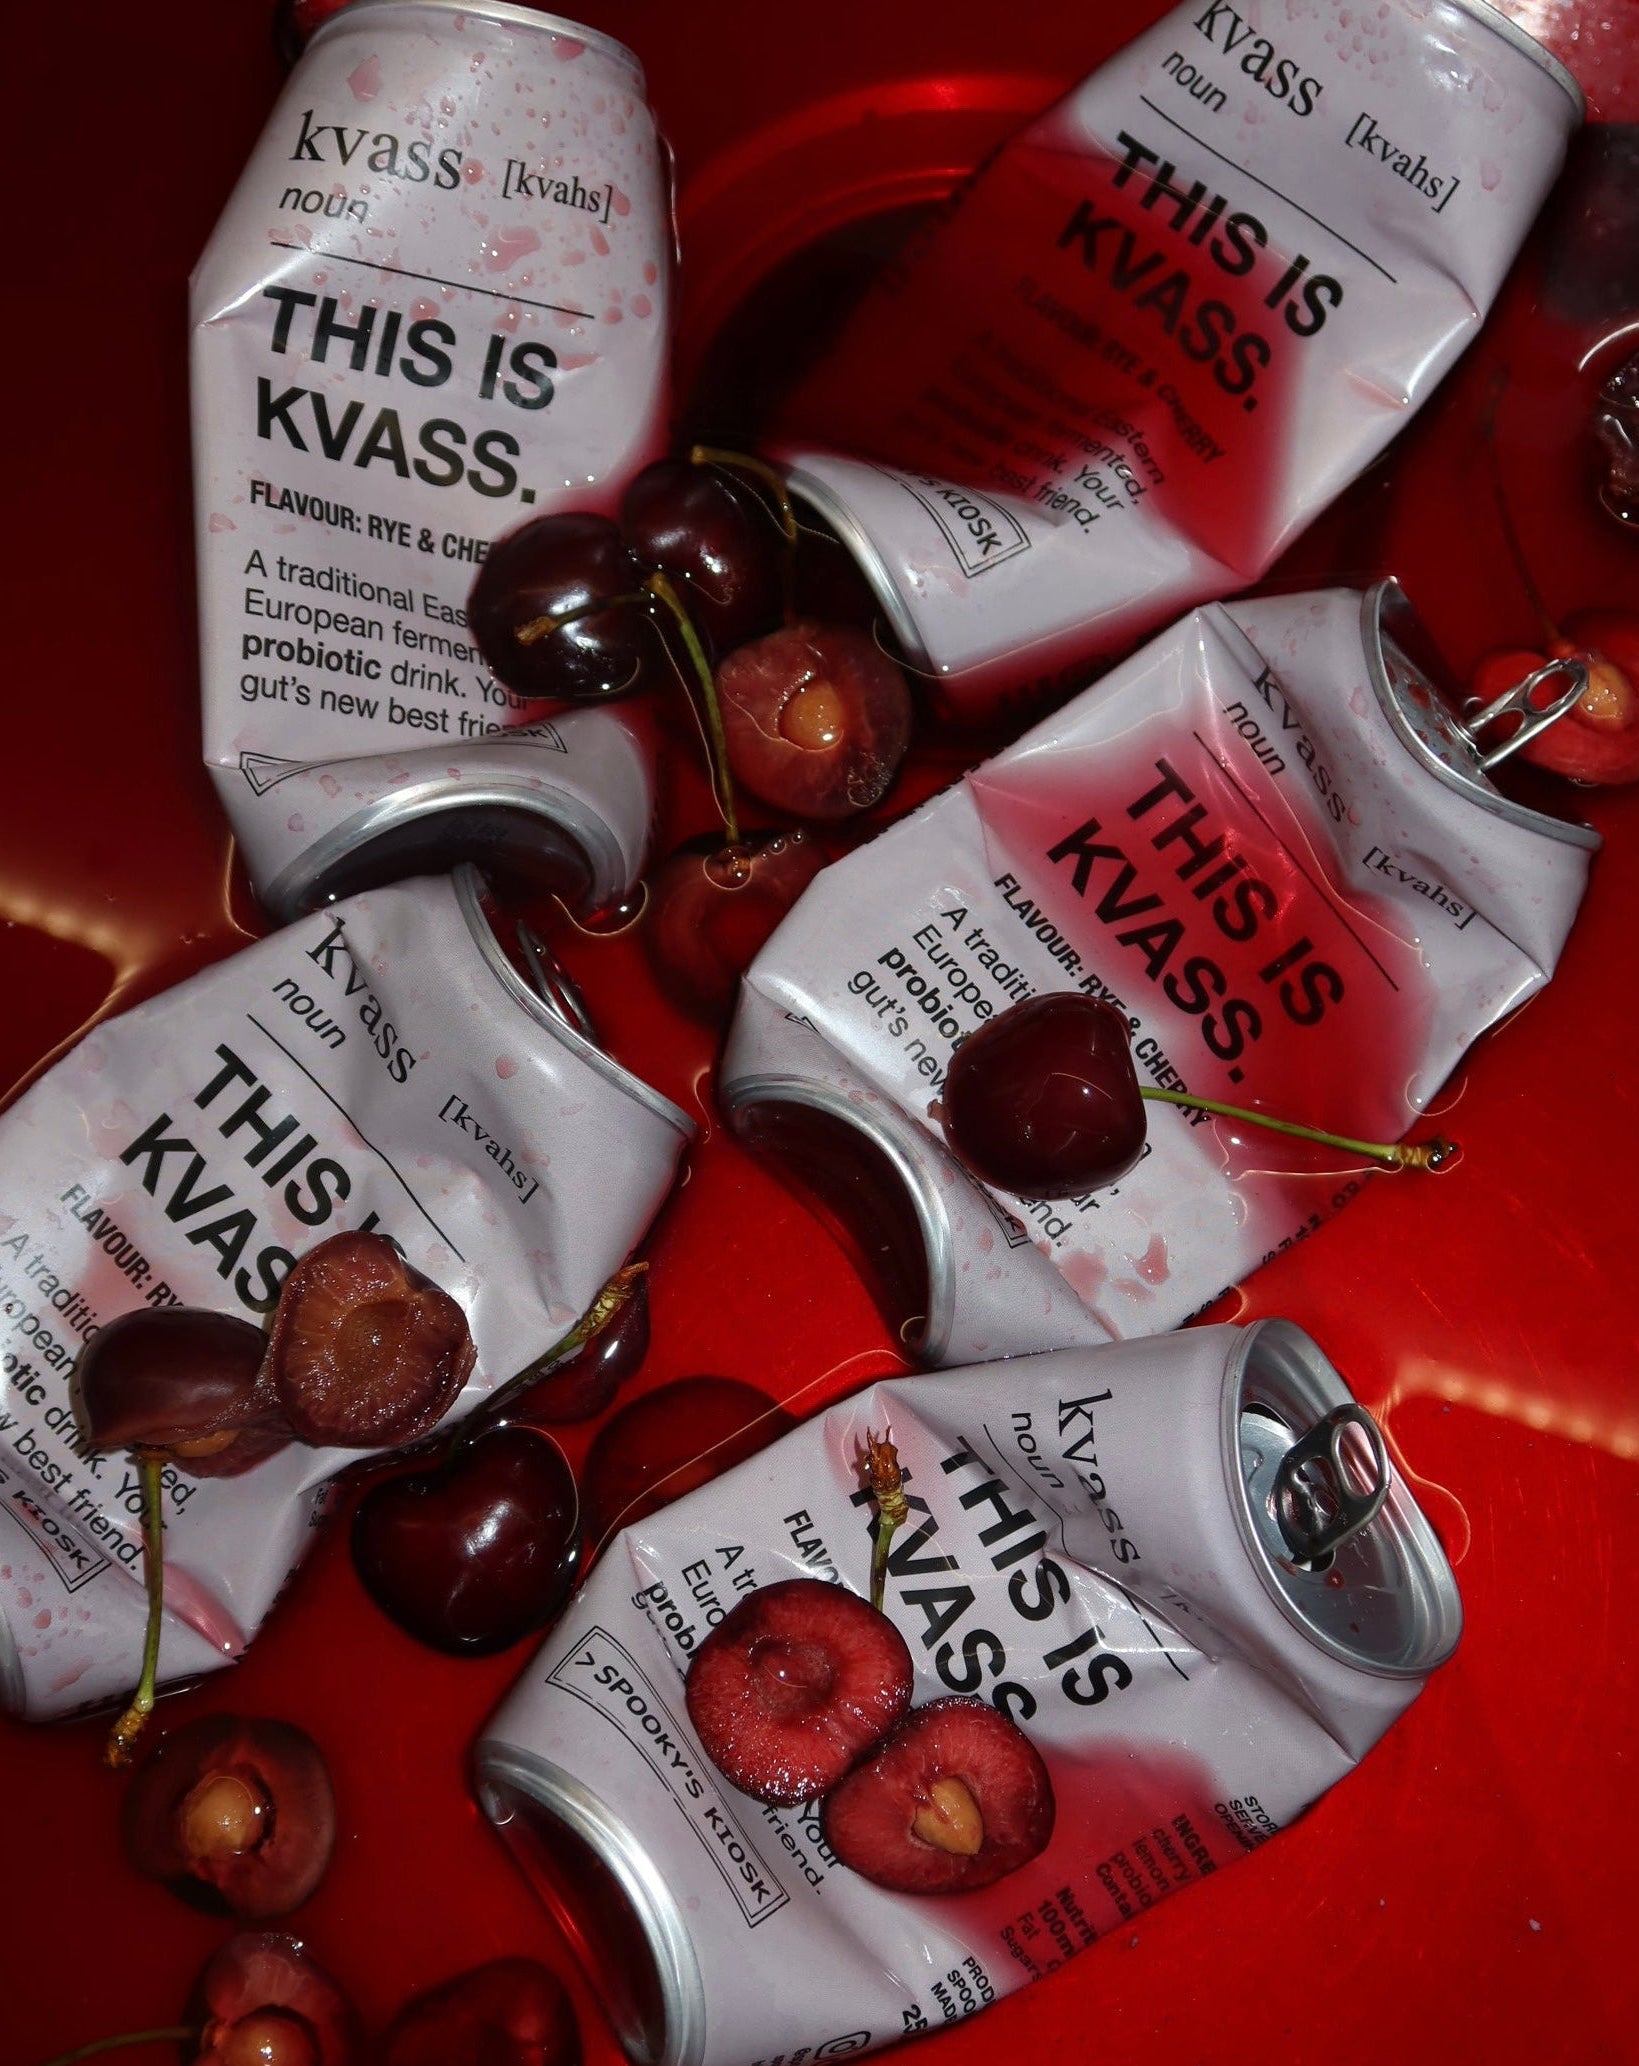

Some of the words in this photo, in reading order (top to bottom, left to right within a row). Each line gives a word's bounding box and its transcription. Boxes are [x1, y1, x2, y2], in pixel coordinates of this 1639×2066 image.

[1162, 51, 1228, 113] noun
[1193, 0, 1323, 117] kvass
[1345, 112, 1461, 214] [kvahs]
[279, 187, 371, 224] noun
[289, 109, 463, 190] kvass
[502, 160, 613, 224] [kvahs]
[1111, 131, 1268, 276] THIS
[1264, 253, 1344, 338] IS
[263, 286, 456, 387] THIS
[479, 334, 559, 411] IS
[1056, 198, 1272, 413] KVASS.
[257, 376, 537, 504] KVASS.
[250, 479, 362, 534] FLAVOUR:
[368, 513, 412, 548] RYE
[418, 528, 435, 553] &
[442, 532, 492, 564] CHE
[935, 488, 1003, 556] KIOSK
[1074, 464, 1125, 510] Your
[244, 549, 268, 577] A
[276, 555, 414, 613] traditional
[423, 593, 468, 628] Eas
[245, 588, 384, 641] European
[392, 619, 484, 666] fermen
[240, 673, 311, 706] gut's
[320, 688, 379, 720] new
[388, 705, 450, 734] best
[458, 711, 512, 737] frie
[241, 633, 382, 680] probiotic
[390, 660, 466, 698] drink.
[1223, 701, 1287, 777] noun
[1251, 665, 1346, 824] kvass
[1361, 846, 1479, 931] [kvahs]
[994, 873, 1085, 978] FLAVOUR:
[1126, 757, 1279, 943] THIS
[1258, 936, 1345, 1027] IS
[912, 923, 995, 1022] Europe
[940, 906, 969, 931] A
[964, 928, 1037, 1005] traditi
[1046, 818, 1263, 1085] KVASS.
[272, 978, 347, 1050] noun
[847, 968, 910, 1038] gut's
[878, 946, 973, 1051] probiot
[305, 917, 417, 1084] kvass
[438, 1094, 541, 1204] [kvahs]
[193, 1043, 352, 1227] THIS
[0, 1233, 30, 1262] A
[60, 1183, 153, 1290] FLAVOUR:
[119, 1112, 297, 1315] KVAS
[1011, 1412, 1065, 1489] noun
[1058, 1388, 1141, 1565] kvass
[12, 1490, 91, 1570] KIOSK
[13, 1428, 74, 1494] best
[67, 1488, 144, 1572] friend.
[681, 1558, 727, 1628] Euro
[715, 1545, 745, 1570] A
[940, 1435, 1072, 1622] THIS
[1044, 1624, 1133, 1706] IS
[594, 1665, 705, 1800] SPOOKY'S
[703, 1806, 771, 1905] KIOSK
[1244, 1795, 1279, 1835] STOR
[1110, 1851, 1153, 1908] probio
[947, 1969, 976, 2014] SPOO
[962, 1956, 996, 2004] PROD
